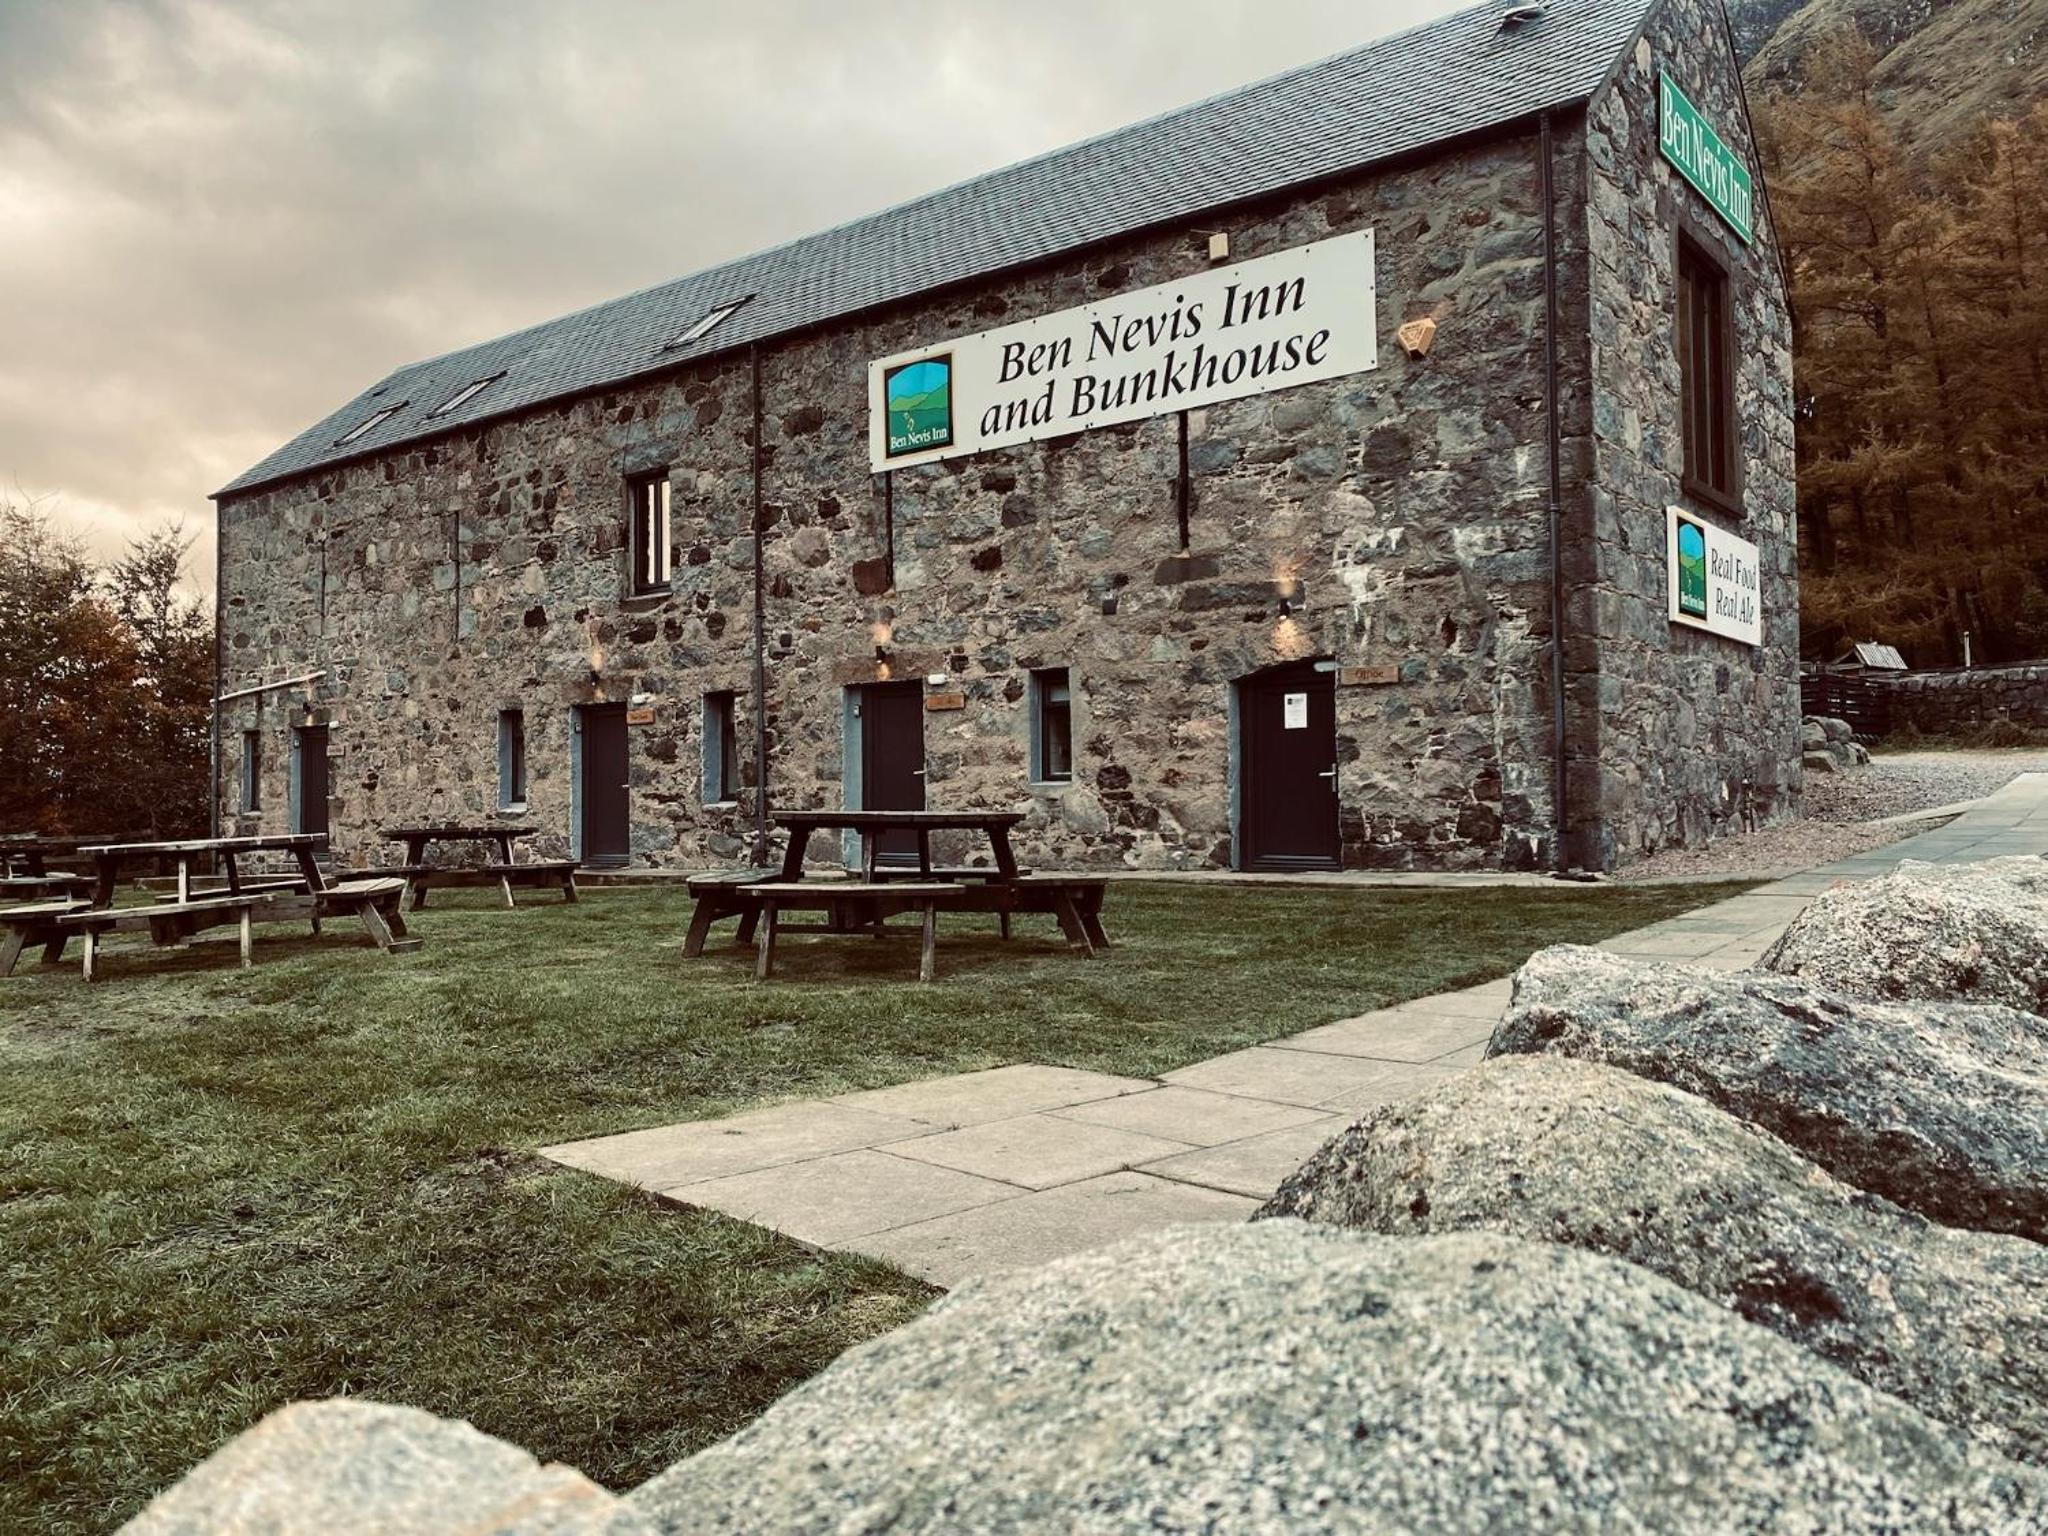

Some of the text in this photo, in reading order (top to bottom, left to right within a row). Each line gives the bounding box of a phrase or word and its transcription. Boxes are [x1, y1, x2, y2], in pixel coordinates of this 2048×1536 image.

[1662, 82, 1750, 233] Ben Nevis Inn
[997, 277, 1307, 385] Ben Nevis Inn
[979, 329, 1331, 439] and Bunkhouse
[891, 427, 948, 449] Ben Nevis Inn
[1711, 547, 1734, 582] Real
[1715, 587, 1738, 619] Real
